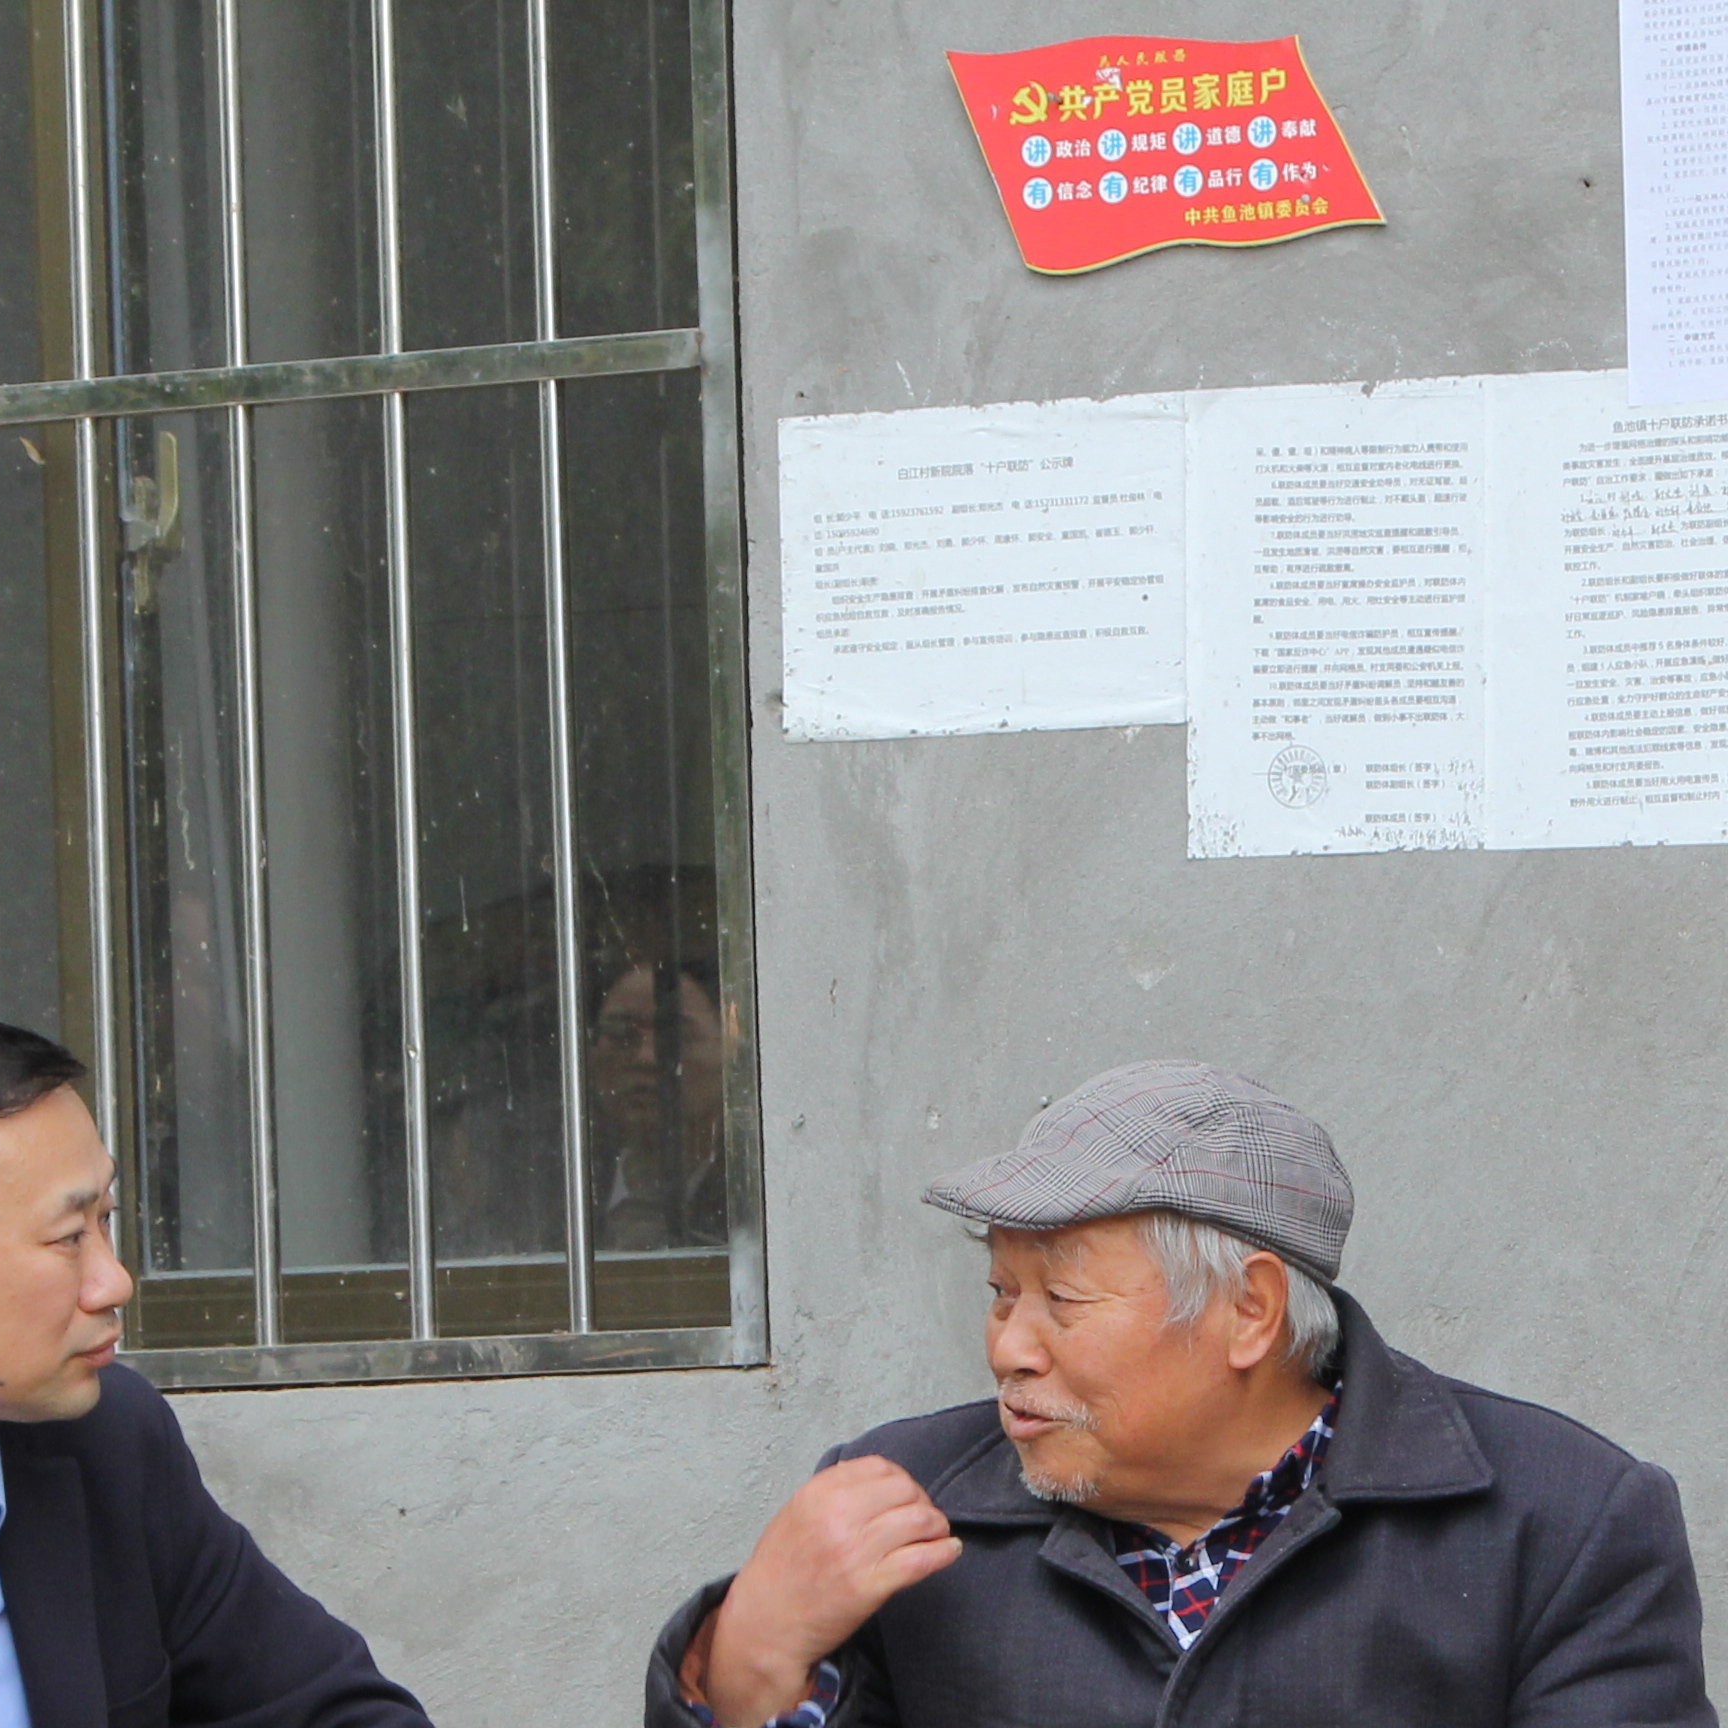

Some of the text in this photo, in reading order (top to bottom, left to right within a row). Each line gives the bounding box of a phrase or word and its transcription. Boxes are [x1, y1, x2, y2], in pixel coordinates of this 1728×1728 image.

[1058, 66, 1288, 124] 共产党员家庭户
[1184, 196, 1330, 227] 中共鱼池镇委员会
[1612, 412, 1728, 433] 鱼池镇十户联防承诺书
